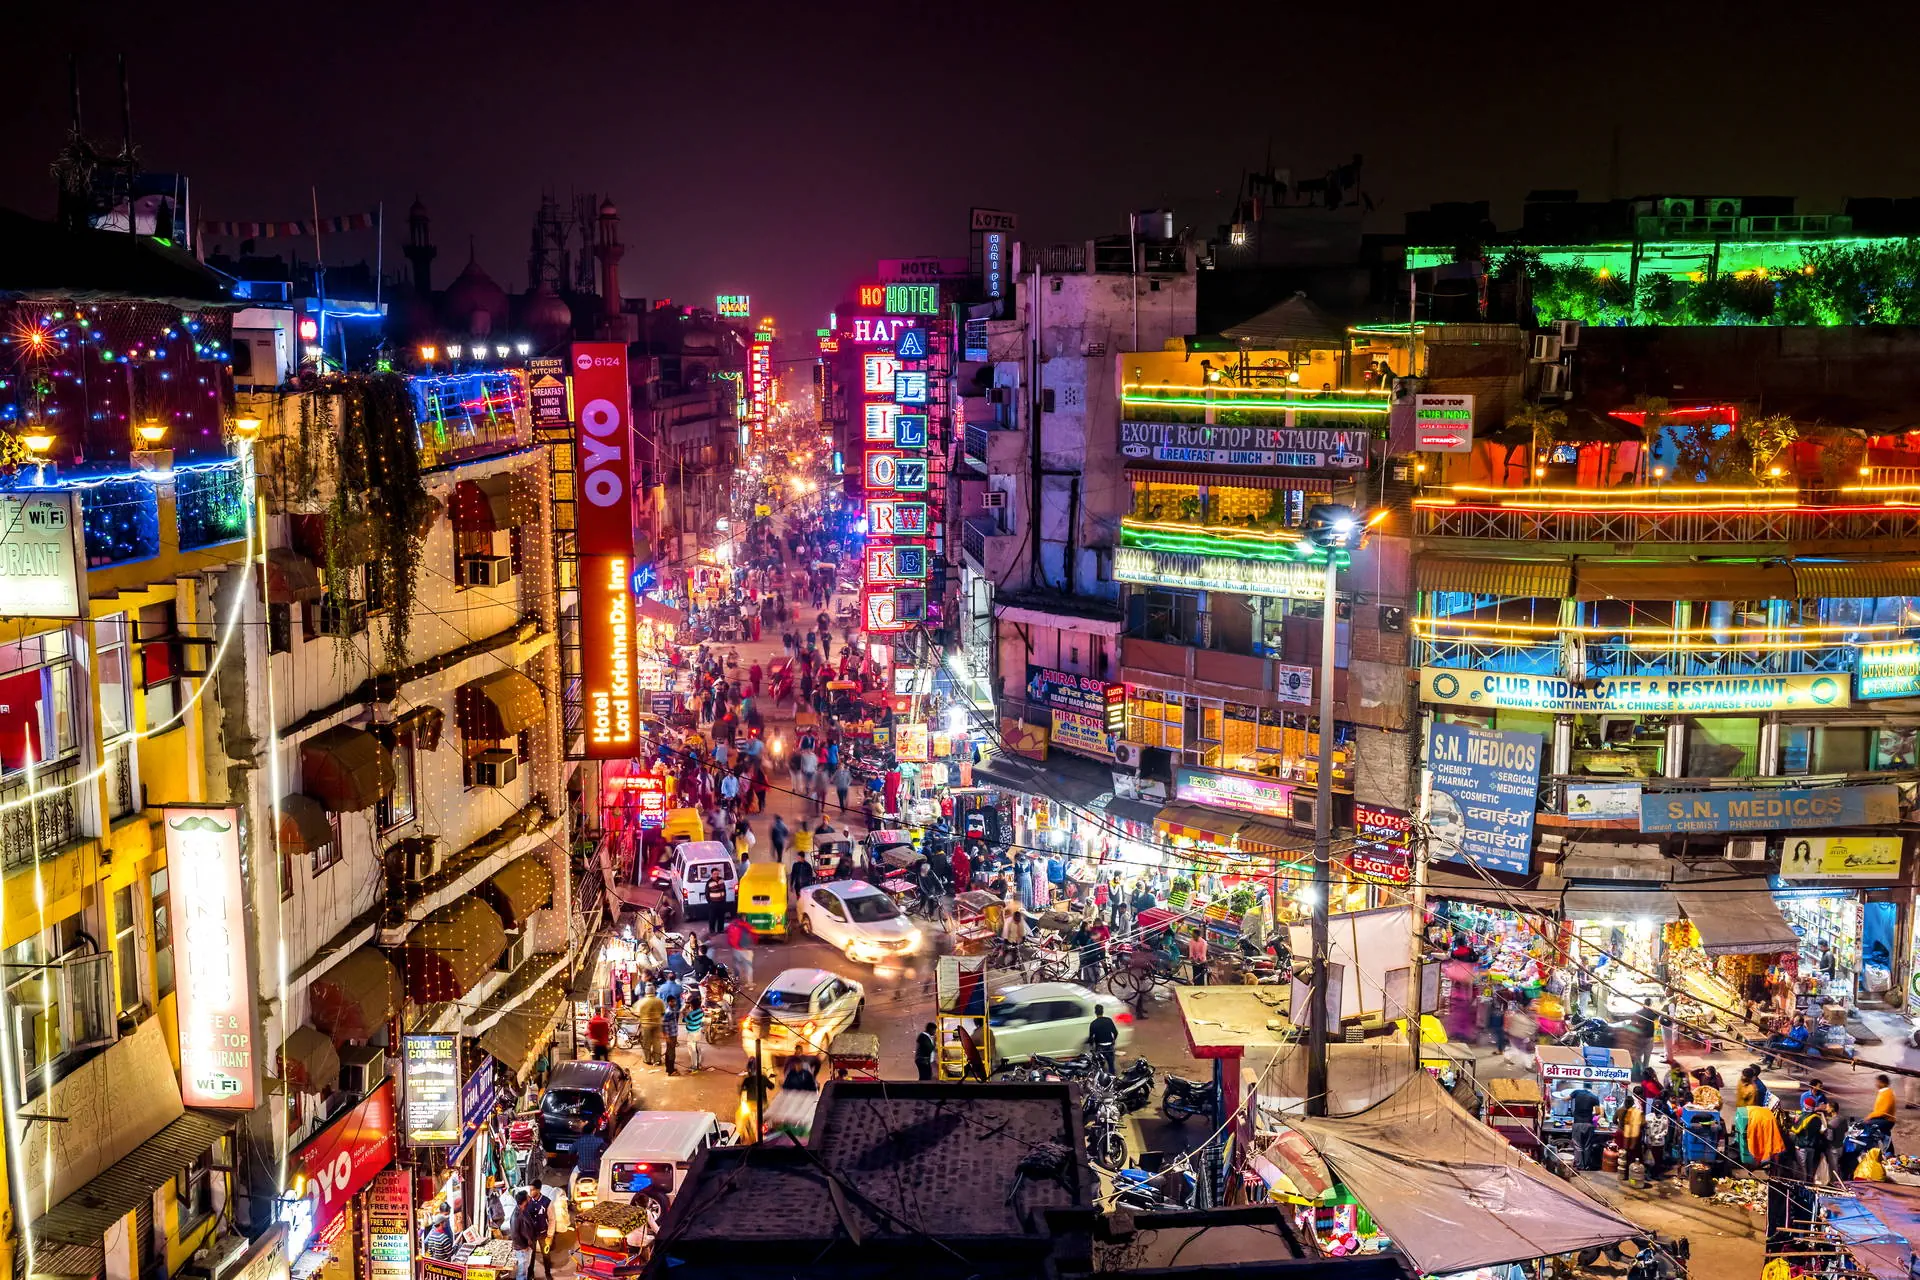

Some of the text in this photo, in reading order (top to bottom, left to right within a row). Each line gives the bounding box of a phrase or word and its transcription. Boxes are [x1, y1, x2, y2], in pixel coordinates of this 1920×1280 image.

[886, 286, 938, 314] HOTEL
[531, 359, 562, 367] EVEREST
[595, 357, 620, 367] 6124
[532, 367, 563, 375] KITCHEN
[533, 388, 565, 397] BREAKFAST
[540, 397, 559, 406] LUNCH
[540, 407, 561, 416] DINNER
[1443, 409, 1470, 420] INDIA
[1121, 423, 1367, 451] EXOTIC ROOFTOP RESTAURANT
[582, 399, 623, 507] OYO
[1160, 447, 1316, 466] BREAKFAST LUNCH DINNER
[1155, 552, 1206, 577] ROOFTOP
[608, 559, 625, 591] Inn
[1043, 669, 1077, 688] HIRA
[1483, 675, 1787, 699] CLUB INDIA CAFE & RESTAURANT
[1050, 693, 1083, 706] READY MADE
[1496, 697, 1773, 710] INDIAN CONTINENTAL CHINESE & JAPANESE FOOD
[593, 692, 609, 742] Hotel
[613, 699, 630, 742] Lord
[1055, 710, 1104, 730] HIRA SONS
[1434, 734, 1537, 772] S.N. MEDICOS
[1438, 763, 1473, 776] CHEMIST
[1437, 775, 1480, 789] PHARMACY
[1497, 772, 1537, 786] SERGICAL
[1496, 783, 1535, 797] MEDICINE
[1460, 790, 1500, 805] COSMETIC
[1667, 796, 1843, 819] S.N. MEDICOS
[1677, 820, 1719, 830] CHEMIST
[1729, 818, 1780, 829] PHARMACY
[1375, 843, 1389, 851] OPEN
[1354, 858, 1406, 877] EXOTIC
[228, 1015, 238, 1029] &
[223, 1032, 248, 1048] TOP
[407, 1040, 453, 1049] ROOF TOP
